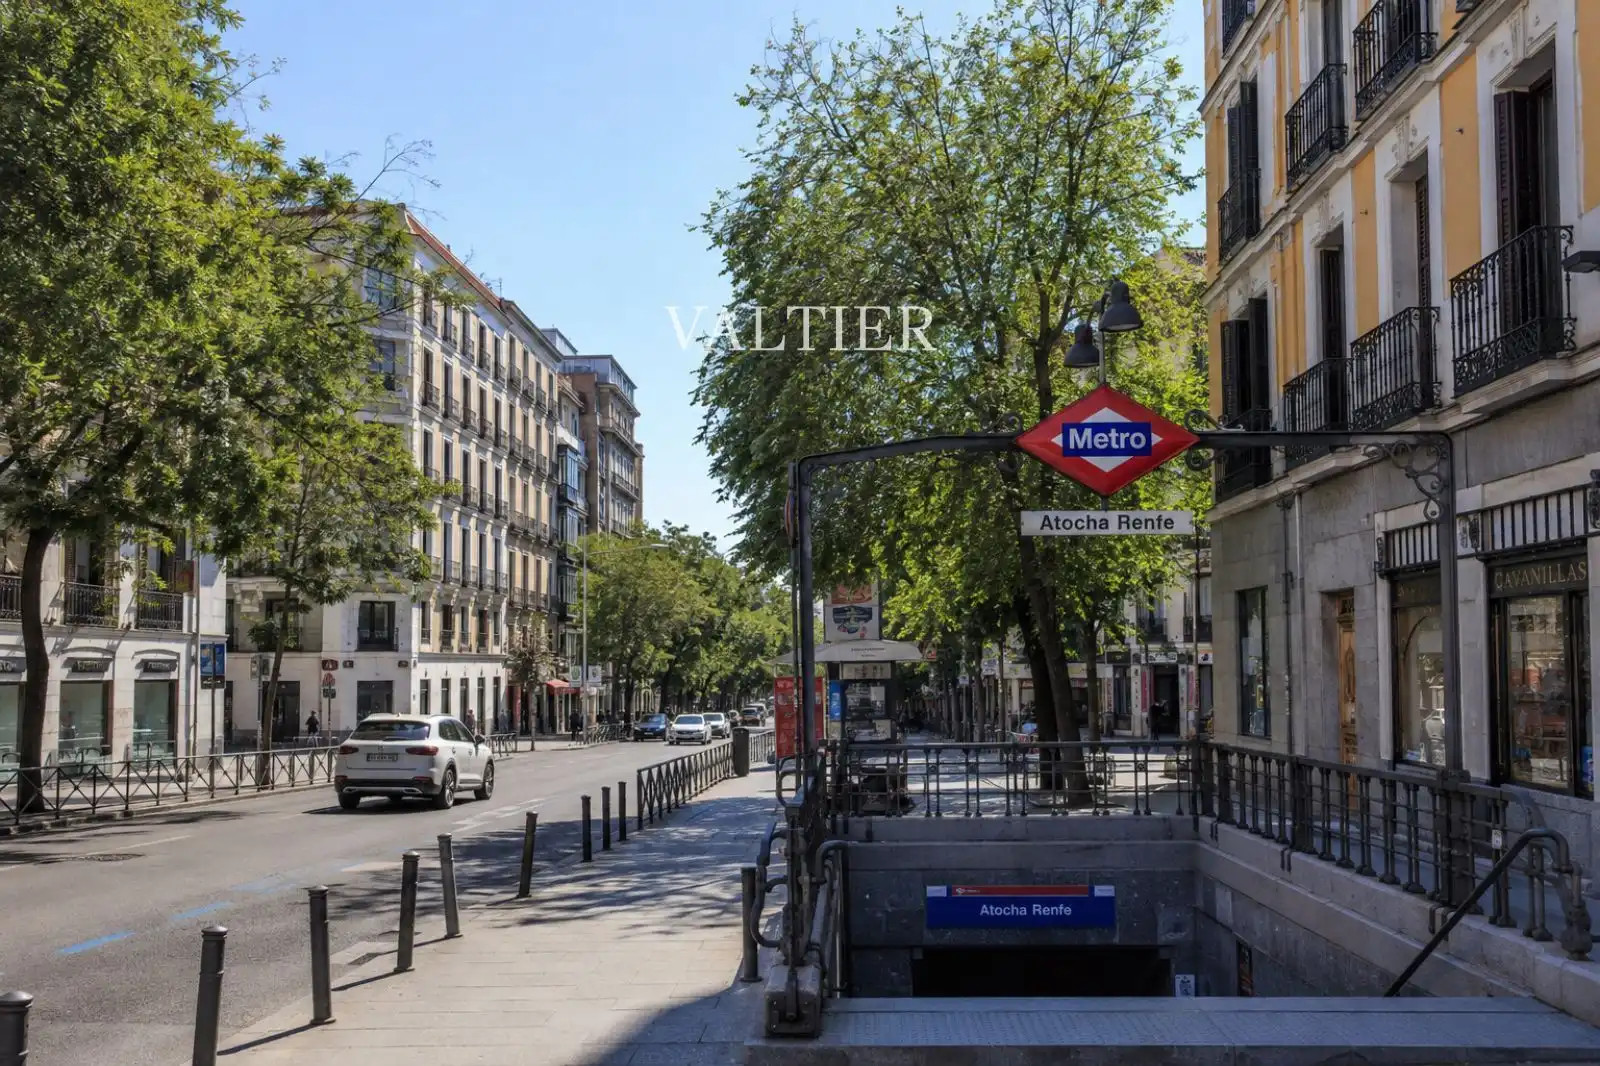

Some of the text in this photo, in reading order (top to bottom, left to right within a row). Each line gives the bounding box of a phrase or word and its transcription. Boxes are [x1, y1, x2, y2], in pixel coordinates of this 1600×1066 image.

[1069, 427, 1147, 450] Metro
[1040, 514, 1175, 531] Atocha Renfe
[1494, 561, 1587, 589] CAVANILLAS
[980, 904, 1072, 916] Atocha Renfe
